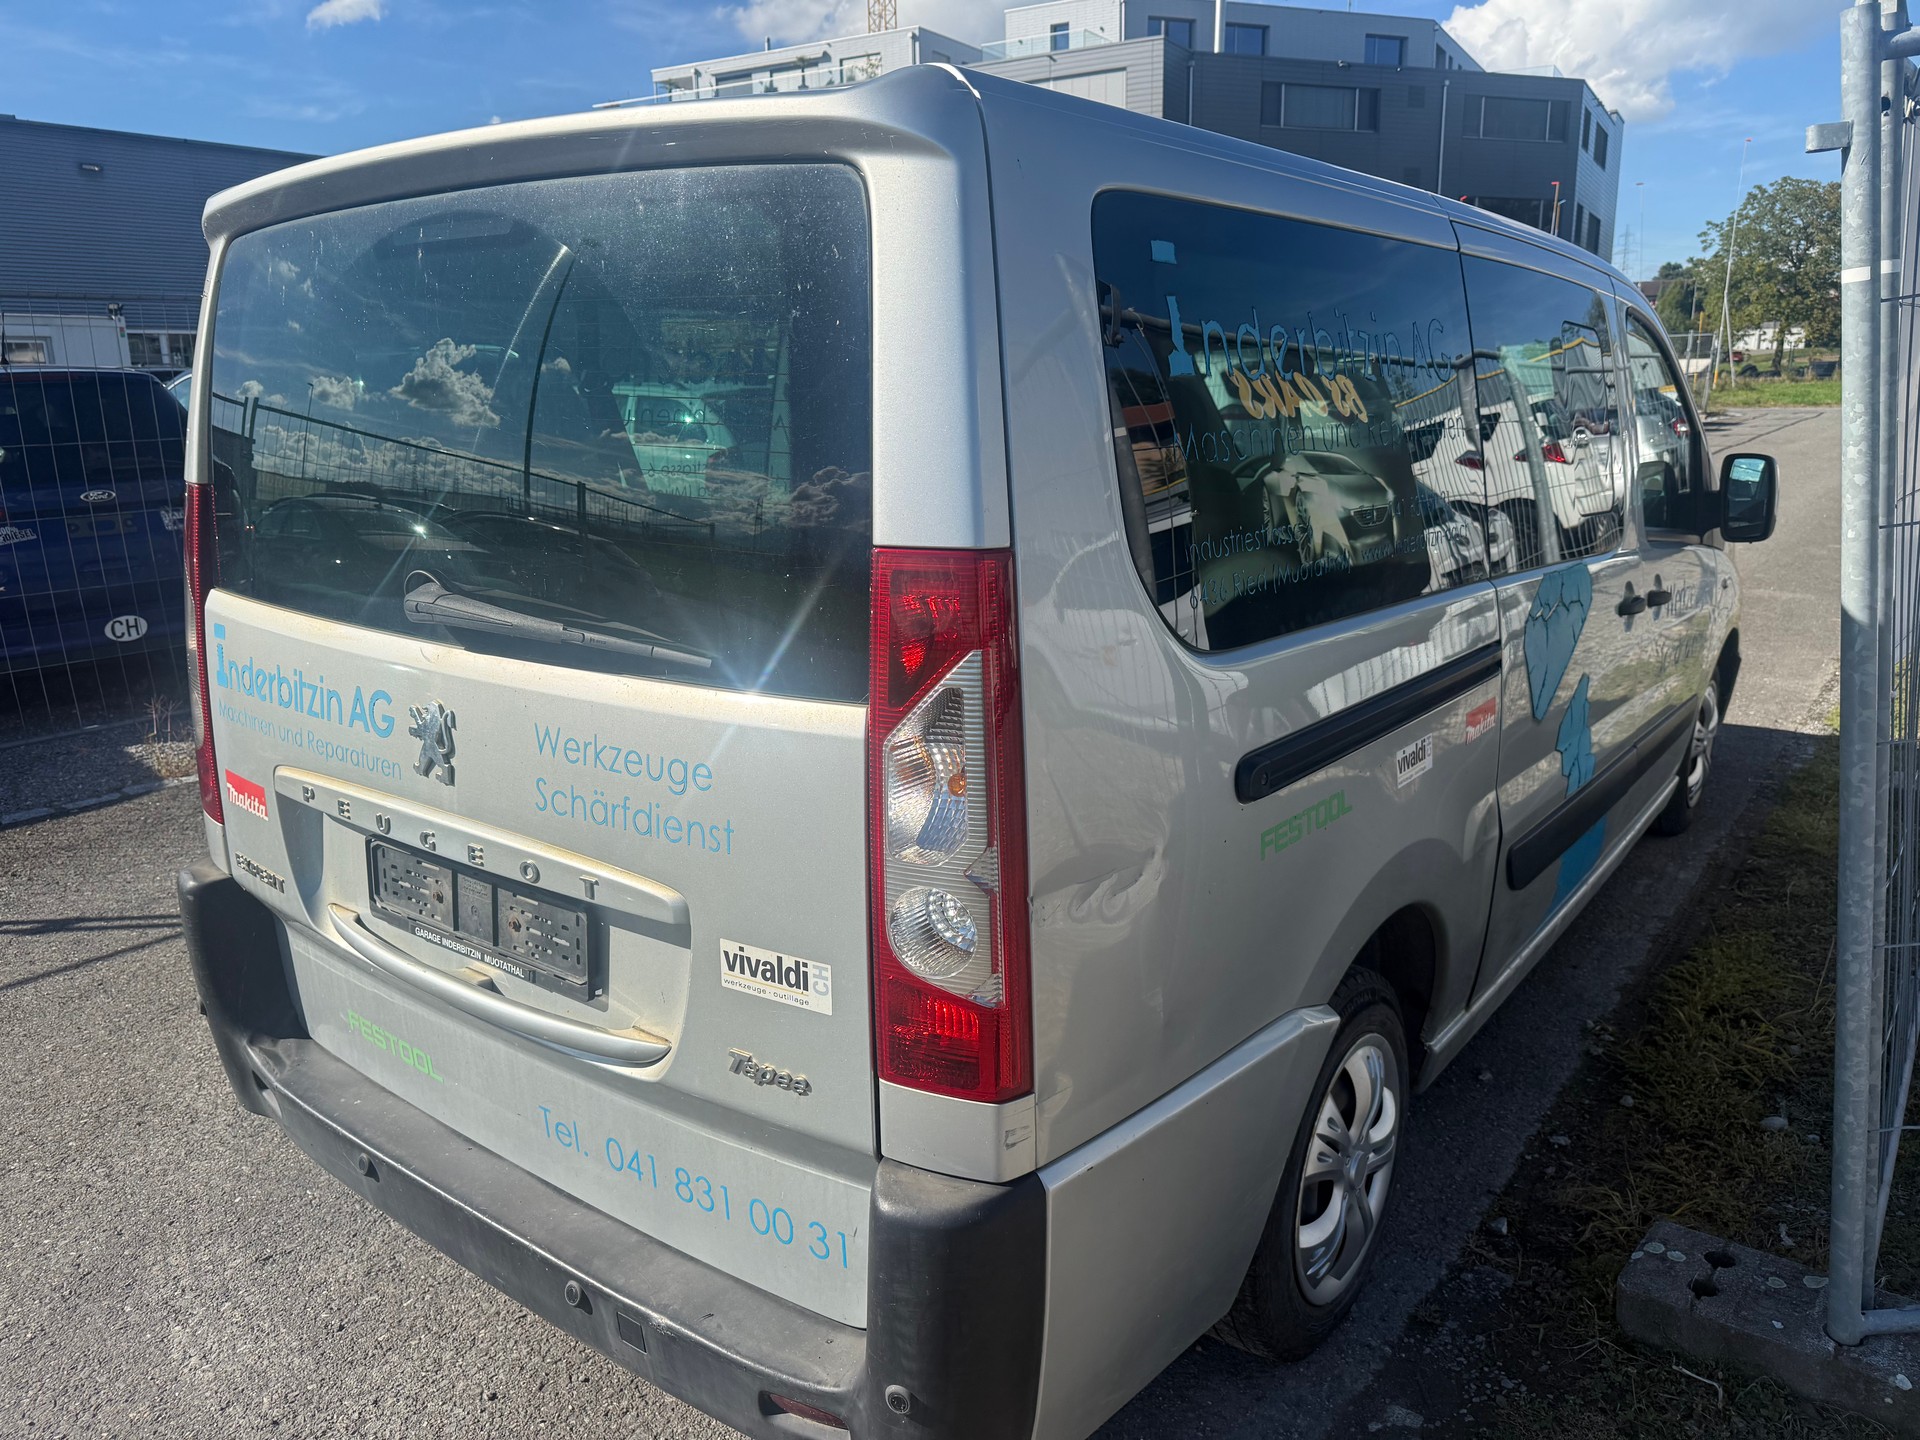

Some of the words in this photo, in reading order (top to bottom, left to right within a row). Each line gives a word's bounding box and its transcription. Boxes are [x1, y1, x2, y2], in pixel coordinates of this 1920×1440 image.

[1412, 318, 1452, 382] AG
[1171, 419, 1316, 463] Maschinen
[111, 618, 140, 638] CH
[218, 698, 276, 739] Maschinen
[278, 726, 303, 748] und
[307, 731, 402, 780] Reparaturen
[348, 686, 396, 738] AG
[534, 722, 713, 795] Werkzeuge
[1397, 737, 1426, 774] vivaldi
[302, 785, 600, 900] PEUGEOT
[535, 777, 735, 855] Schärfdienst
[1260, 789, 1353, 861] FESTOOL
[414, 926, 441, 944] GARAGE
[440, 931, 482, 960] INDERBITZIN
[484, 953, 525, 978] MUOTATHAL
[723, 945, 809, 992] vivaldi
[812, 964, 829, 996] CH
[723, 978, 767, 995] werkzeuge
[773, 991, 810, 1006] outillage
[347, 1008, 444, 1083] FESTOOL
[538, 1105, 589, 1157] Tel.
[605, 1137, 657, 1188] 041
[674, 1167, 731, 1220] 831
[749, 1198, 794, 1245] 00
[808, 1221, 848, 1269] 31
